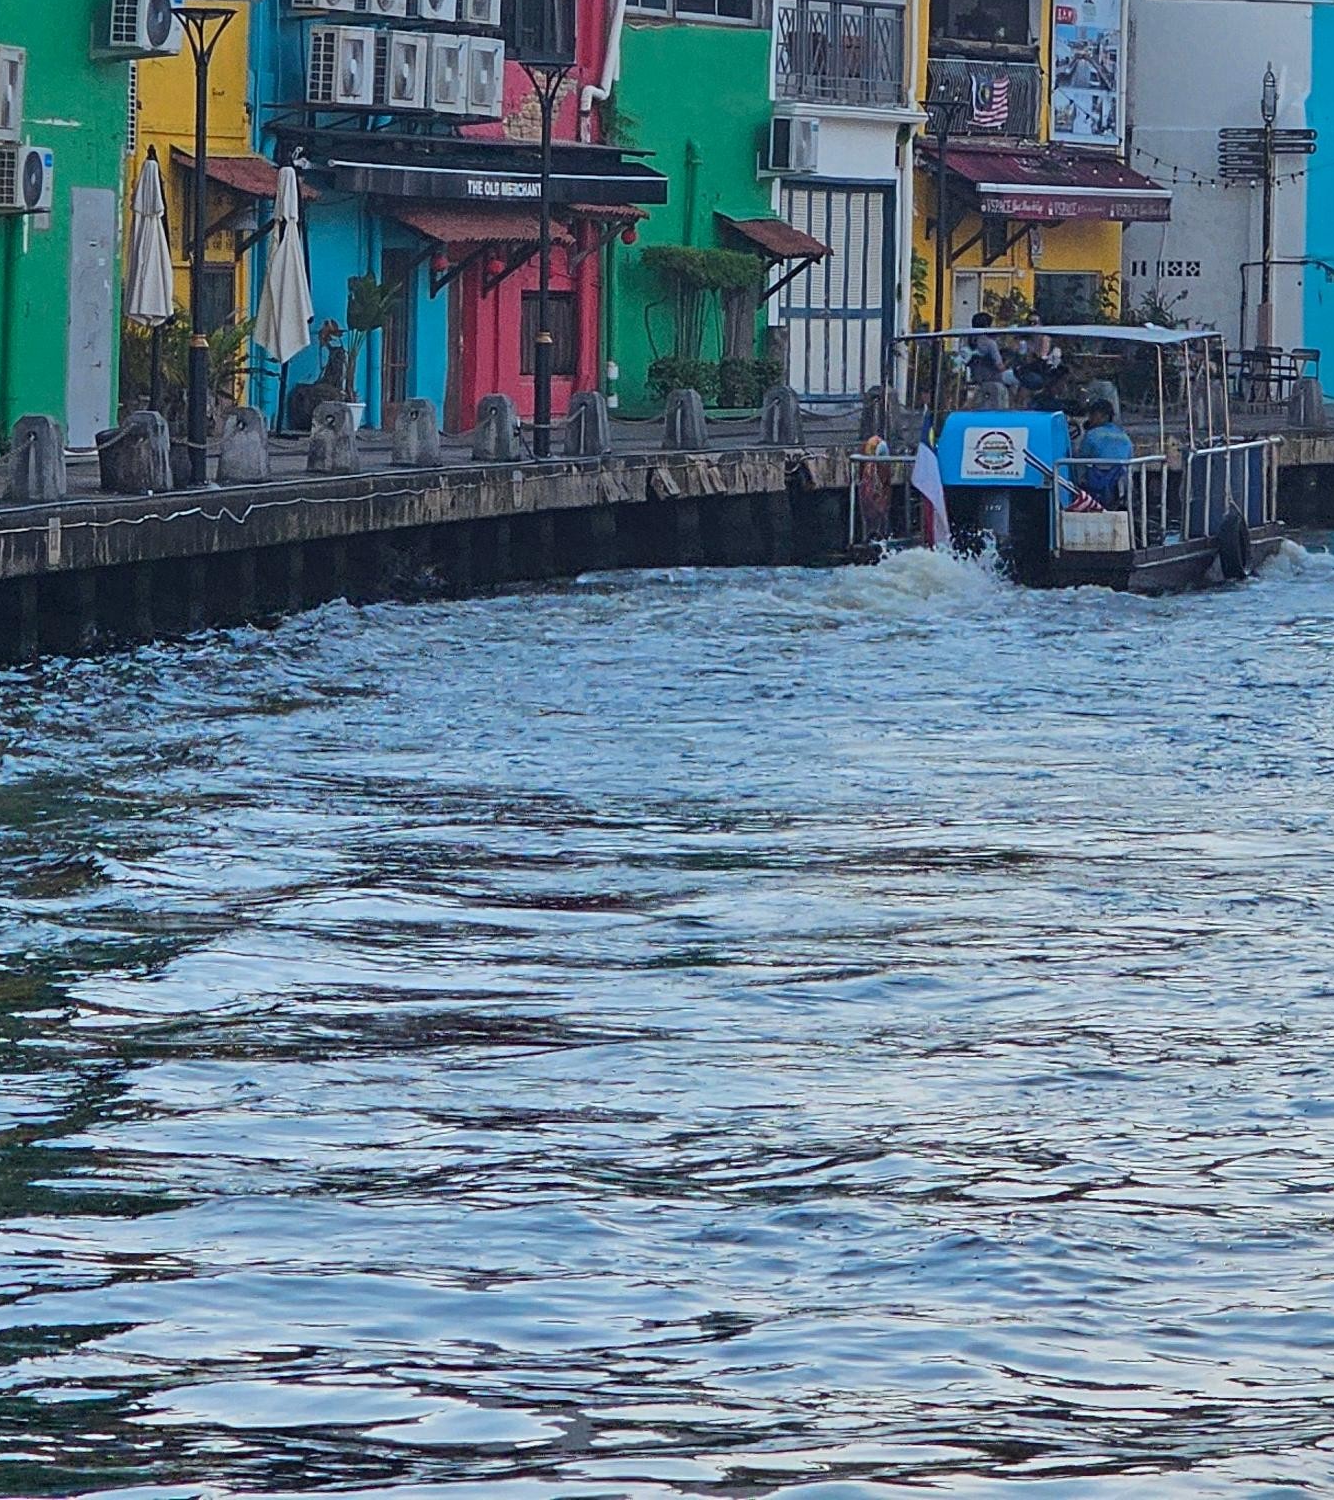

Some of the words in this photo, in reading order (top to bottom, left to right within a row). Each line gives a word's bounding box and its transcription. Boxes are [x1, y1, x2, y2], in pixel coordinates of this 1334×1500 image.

[467, 179, 483, 195] THE
[484, 181, 499, 196] OLD
[501, 182, 542, 197] MERCHANT
